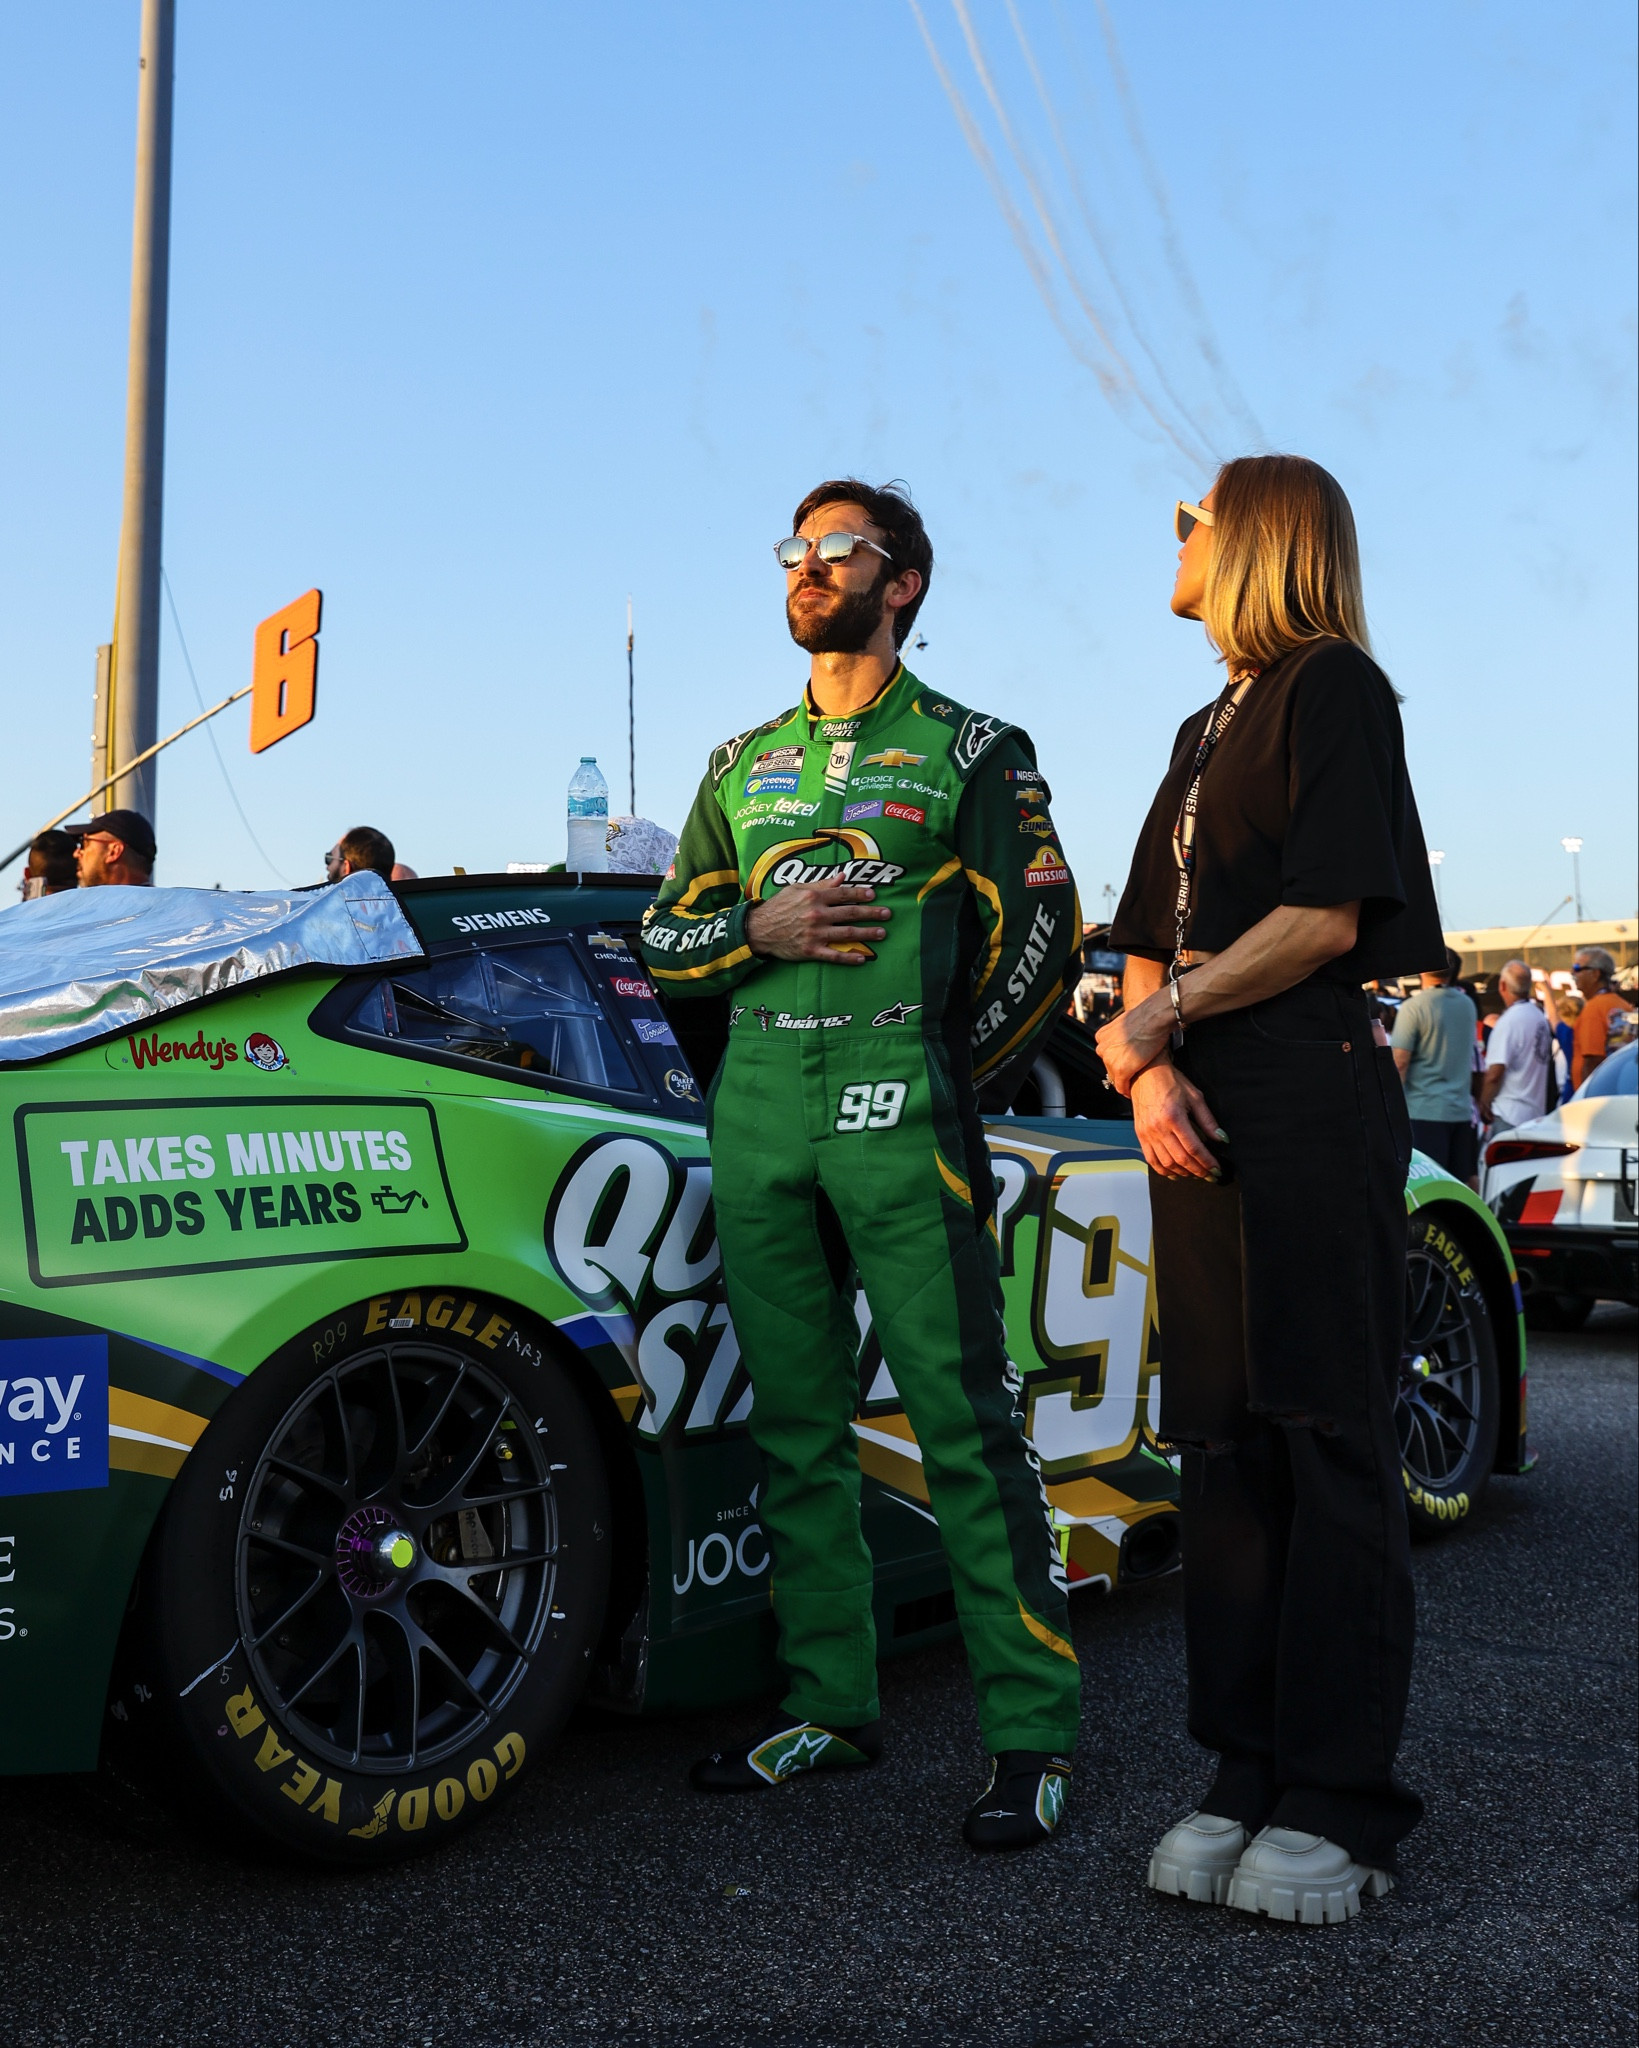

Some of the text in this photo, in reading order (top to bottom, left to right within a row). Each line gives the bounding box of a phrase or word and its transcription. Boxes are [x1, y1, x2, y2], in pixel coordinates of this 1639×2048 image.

[249, 588, 323, 754] 6
[822, 721, 861, 732] QUAKER
[1194, 703, 1236, 768] CUP SERIES
[757, 758, 796, 770] CUP SERIES
[770, 748, 798, 759] NASCAR
[761, 777, 797, 786] Freeway
[860, 775, 894, 783] CHOICE
[912, 782, 948, 800] Kubota
[733, 803, 772, 820] JOCKEY
[773, 797, 820, 817] telcel
[845, 802, 880, 821] Tootsies
[773, 859, 905, 885] QUAKER
[1177, 871, 1188, 911] SERIES
[451, 908, 551, 932] SIEMENS
[1007, 903, 1056, 1004] STATE
[775, 1012, 853, 1030] Suárez
[127, 1030, 239, 1070] Wendy's
[834, 1081, 908, 1132] 99
[60, 1131, 412, 1186] TAKES MINUTES
[70, 1182, 361, 1244] ADDS YEARS
[1424, 1224, 1475, 1286] EAGLE
[362, 1292, 512, 1350] EAGLE
[312, 1321, 348, 1364] R99
[716, 1506, 749, 1521] SINCE
